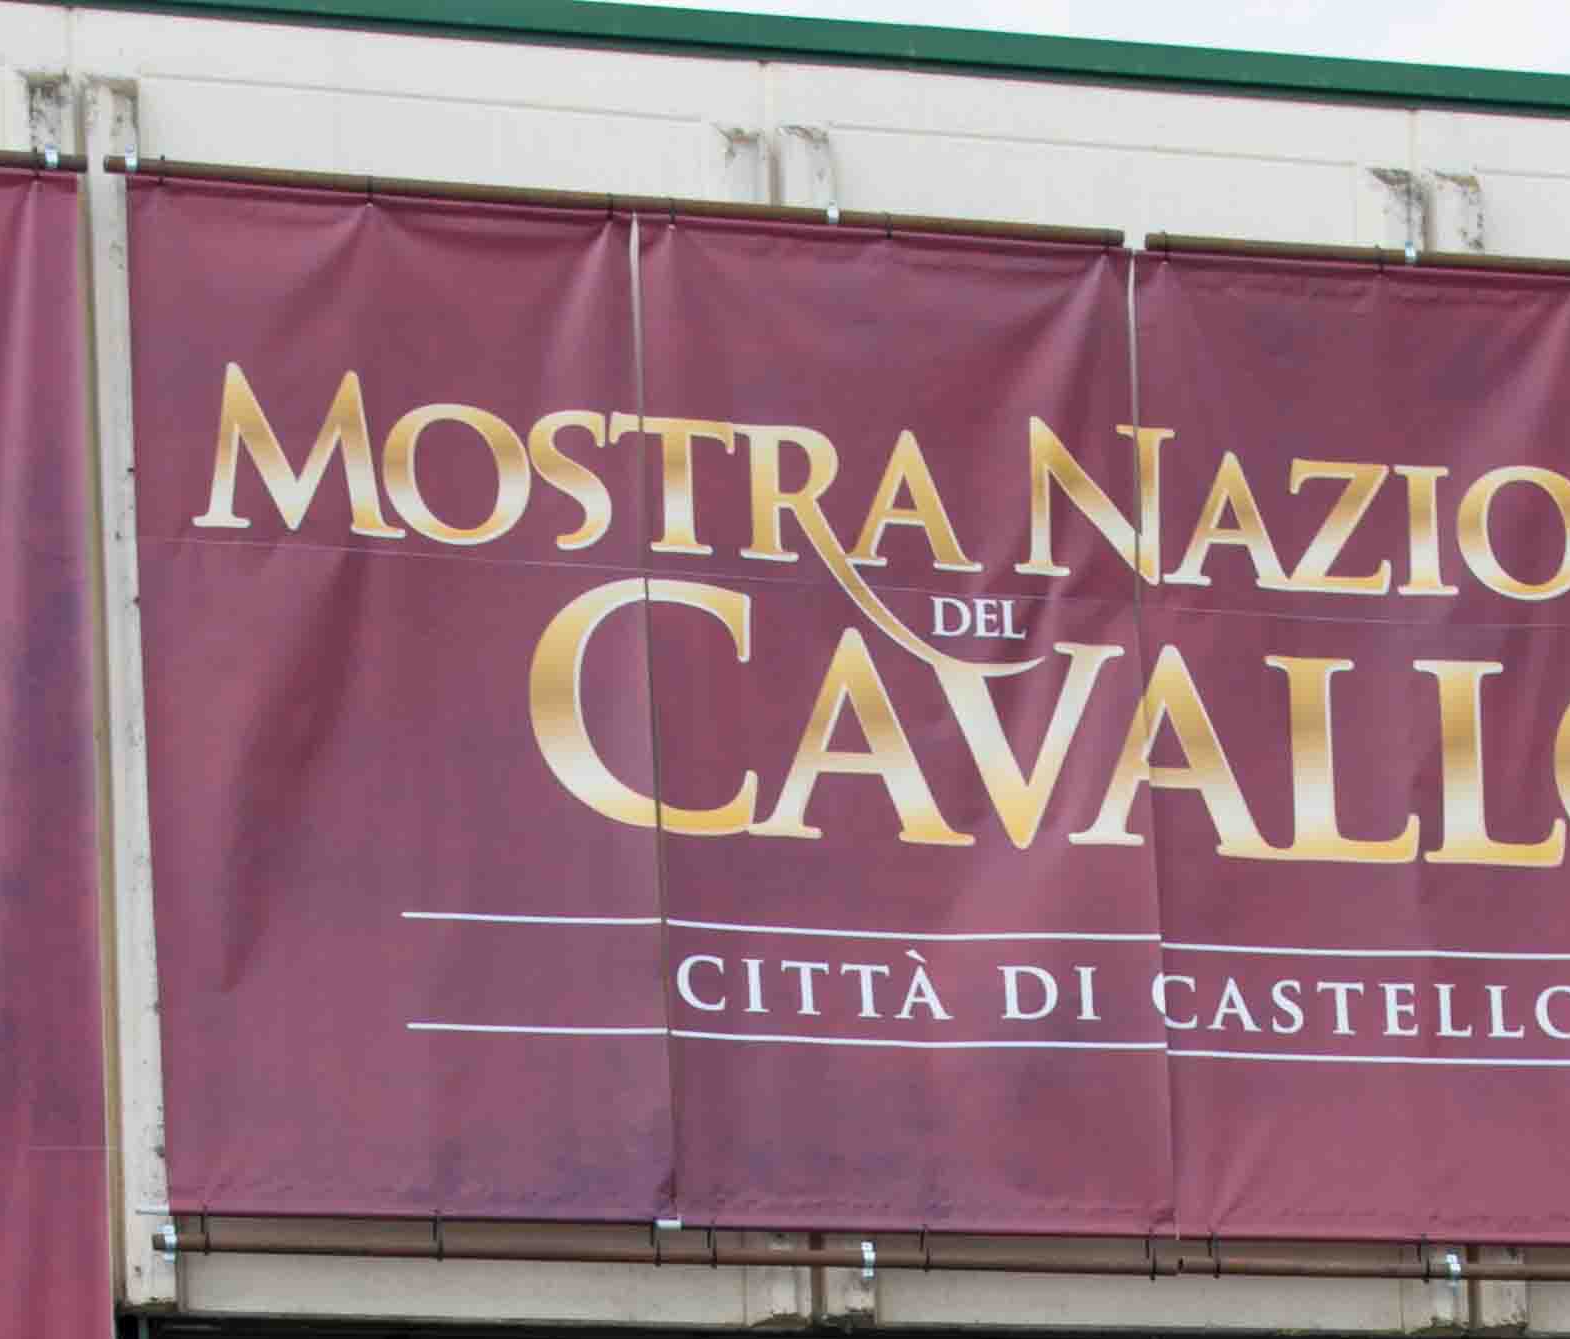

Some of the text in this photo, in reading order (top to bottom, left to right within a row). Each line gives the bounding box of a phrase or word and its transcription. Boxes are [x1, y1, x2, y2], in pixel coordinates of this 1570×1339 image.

[192, 362, 1045, 676] MOSTRA
[932, 597, 1026, 639] DEL
[676, 950, 954, 1021] CITTÀ
[1000, 965, 1100, 1021] DI
